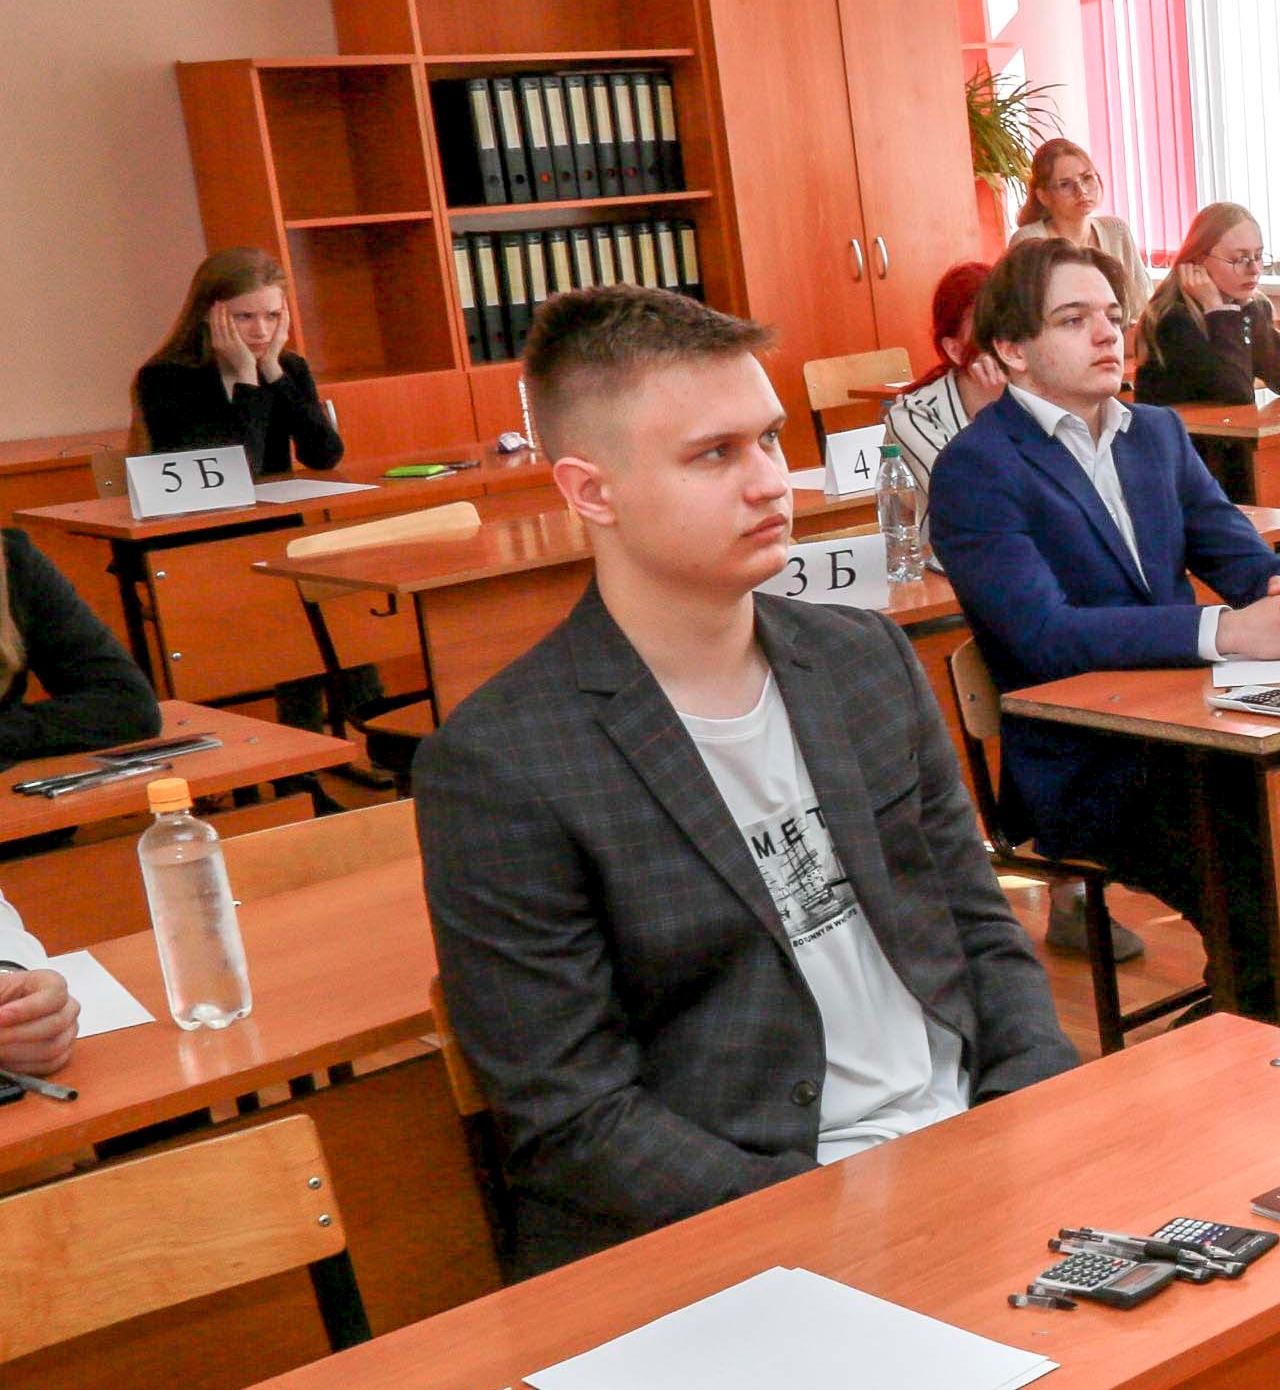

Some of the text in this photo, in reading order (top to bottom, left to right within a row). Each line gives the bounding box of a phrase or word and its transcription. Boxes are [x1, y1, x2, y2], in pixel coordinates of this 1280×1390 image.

[161, 457, 225, 494] 5 Б
[853, 448, 871, 480] 4
[785, 549, 857, 597] 3 Б
